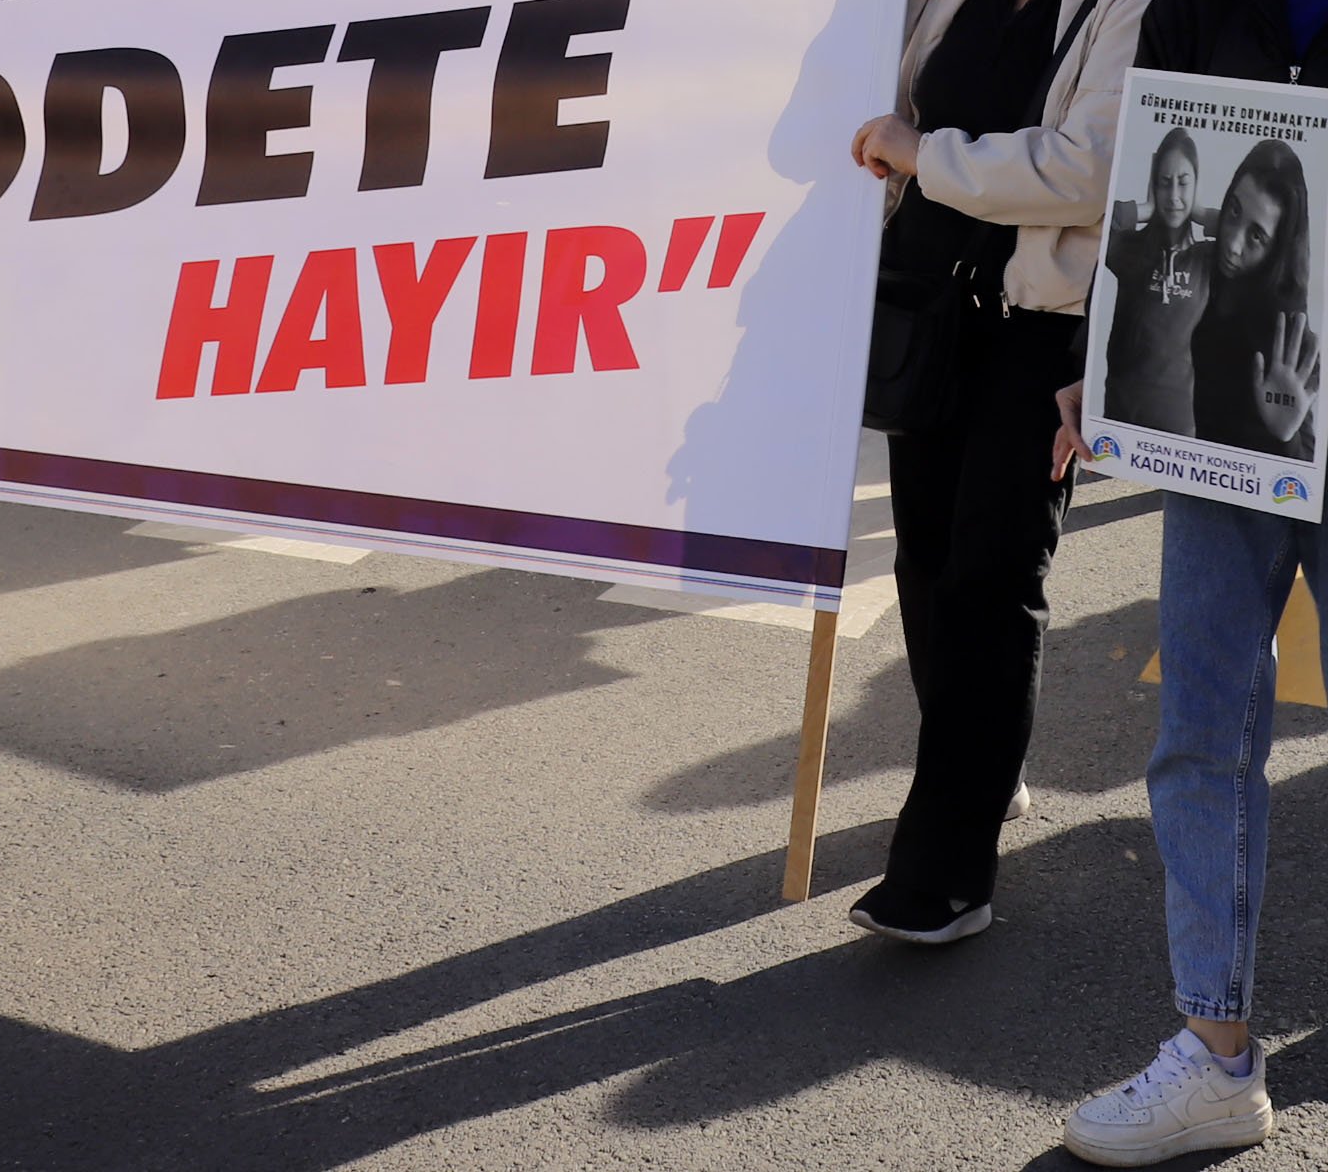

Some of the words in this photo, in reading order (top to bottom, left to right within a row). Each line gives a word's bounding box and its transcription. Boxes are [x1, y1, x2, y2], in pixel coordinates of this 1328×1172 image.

[1140, 92, 1218, 115] GÖRMEMEKTEN
[1222, 105, 1236, 117] VE
[1240, 108, 1328, 129] DUYMAMAKTAN
[1154, 112, 1166, 124] NE
[1171, 114, 1207, 129] ZAMAN
[1265, 390, 1296, 408] DUR!
[1129, 452, 1184, 479] KADIN
[1189, 466, 1262, 495] MECLİSİ
[1136, 439, 1173, 456] KEŞAN
[1174, 449, 1203, 464] KENT
[1206, 456, 1257, 475] KONSEYİ
